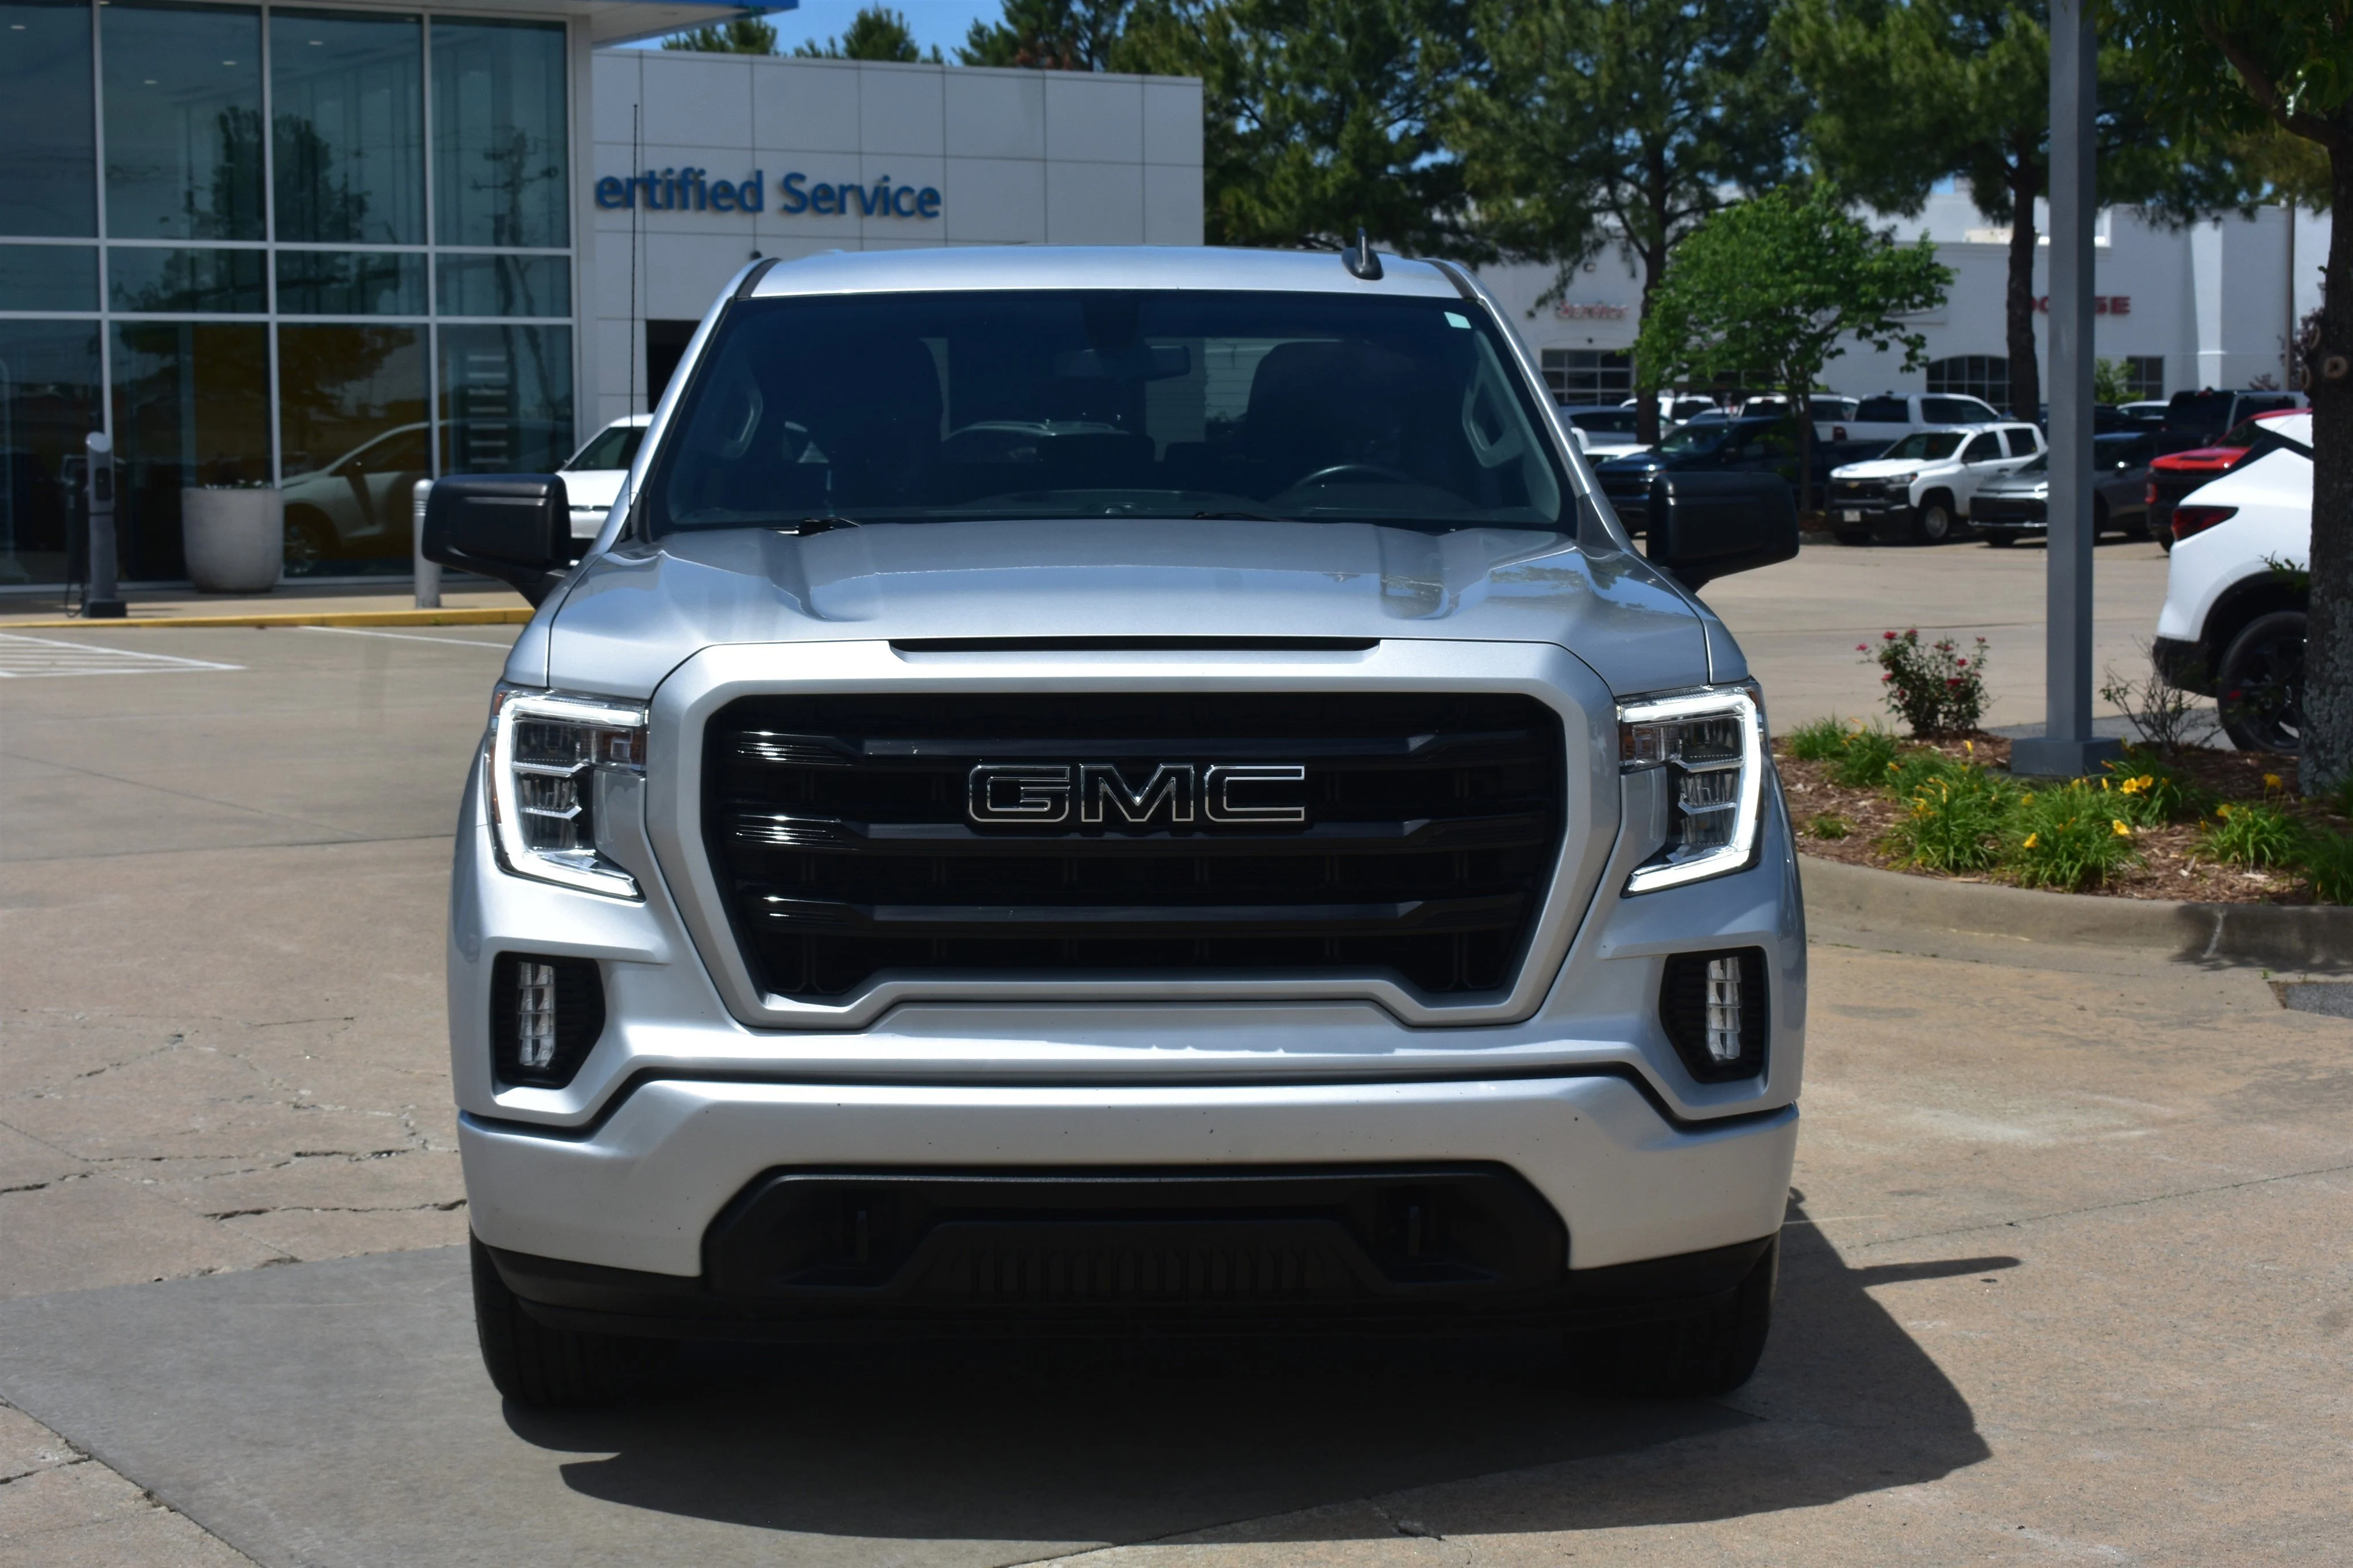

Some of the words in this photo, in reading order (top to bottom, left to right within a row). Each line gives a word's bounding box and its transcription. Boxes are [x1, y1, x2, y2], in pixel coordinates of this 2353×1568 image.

[596, 166, 764, 212] ertified
[782, 172, 942, 218] Service
[969, 763, 1305, 822] GMC
